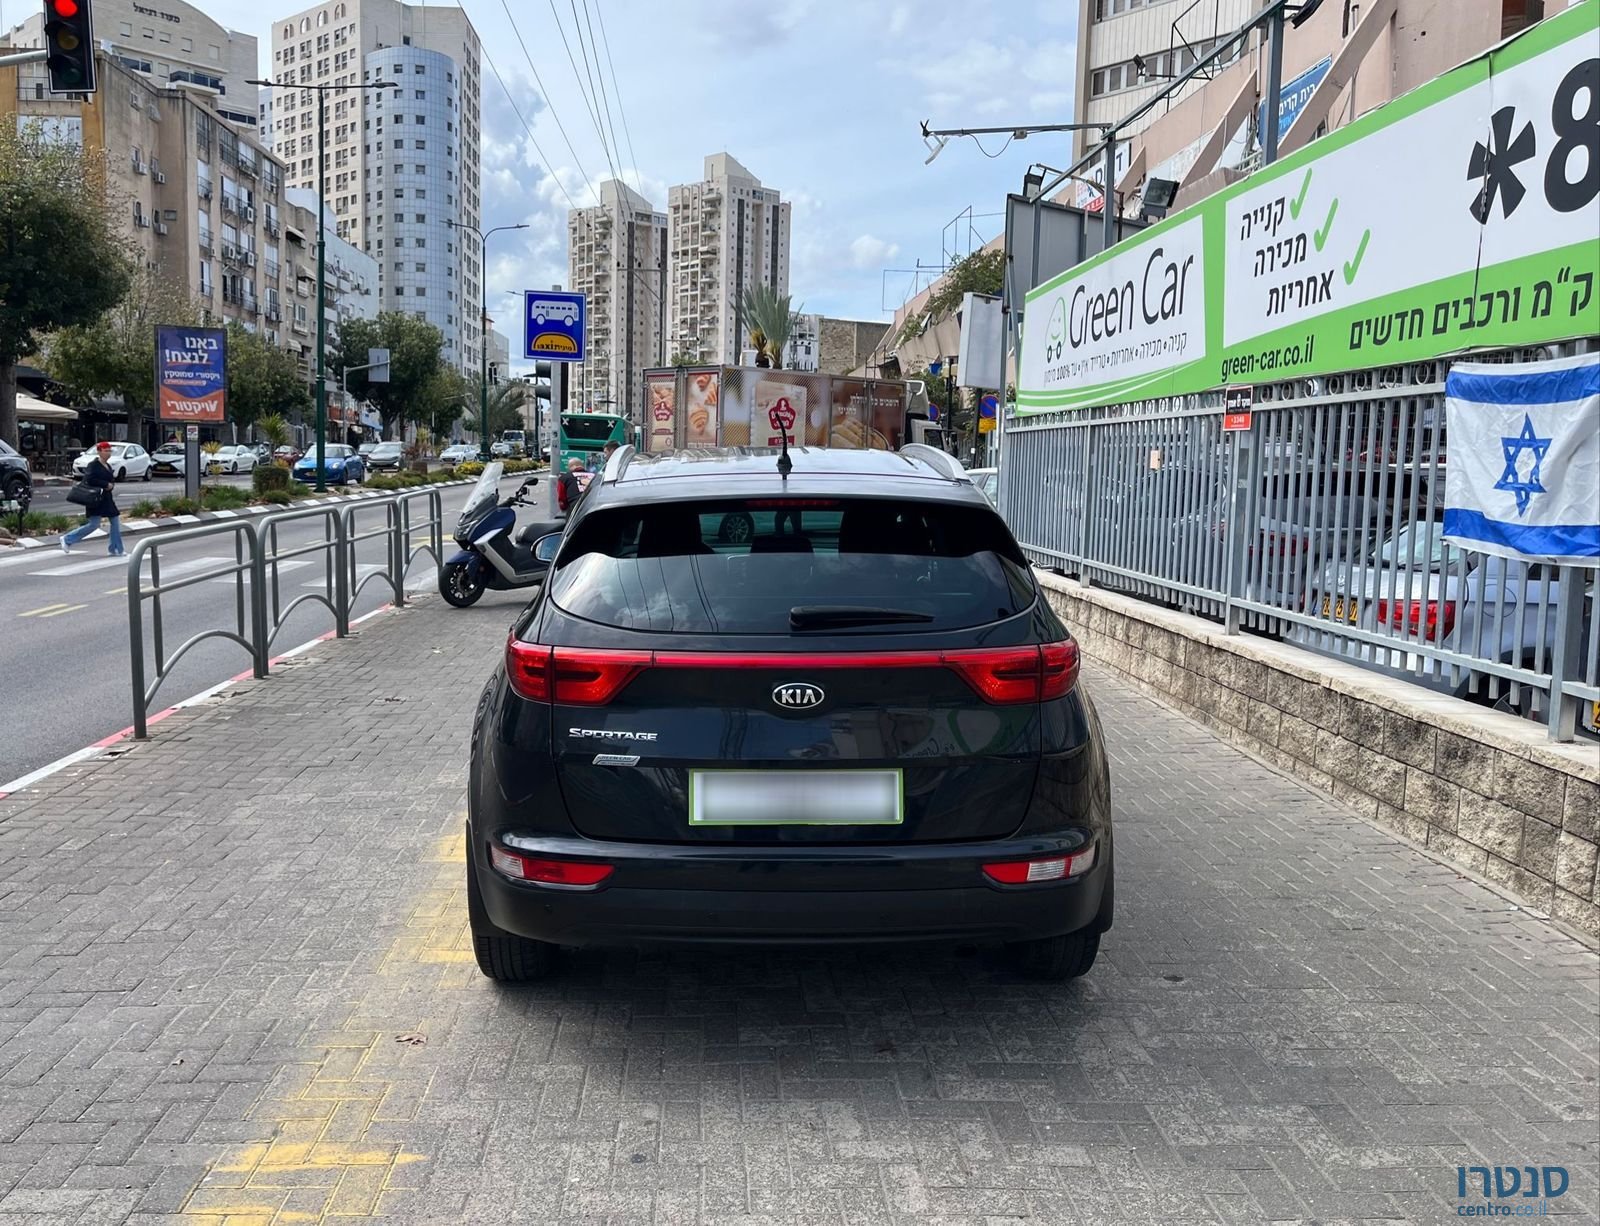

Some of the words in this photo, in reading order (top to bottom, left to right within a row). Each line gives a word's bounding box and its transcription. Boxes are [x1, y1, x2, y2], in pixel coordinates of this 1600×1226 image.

[1241, 196, 1286, 241] קנייה
[1254, 232, 1308, 278] מכירה
[1069, 280, 1135, 349] Green
[1142, 247, 1194, 325] Car
[1267, 269, 1335, 317] אחריות
[1432, 286, 1522, 336] ורכבים
[185, 336, 218, 350] באנו
[1168, 332, 1187, 356] קניה
[1349, 307, 1425, 351] חדשים
[165, 349, 208, 364] לנצח!
[1110, 345, 1135, 367] אחריות
[1139, 338, 1162, 360] מכירה
[1221, 334, 1315, 383] green-car.co.il
[781, 688, 817, 705] KIA
[568, 727, 659, 742] SPORTAGE
